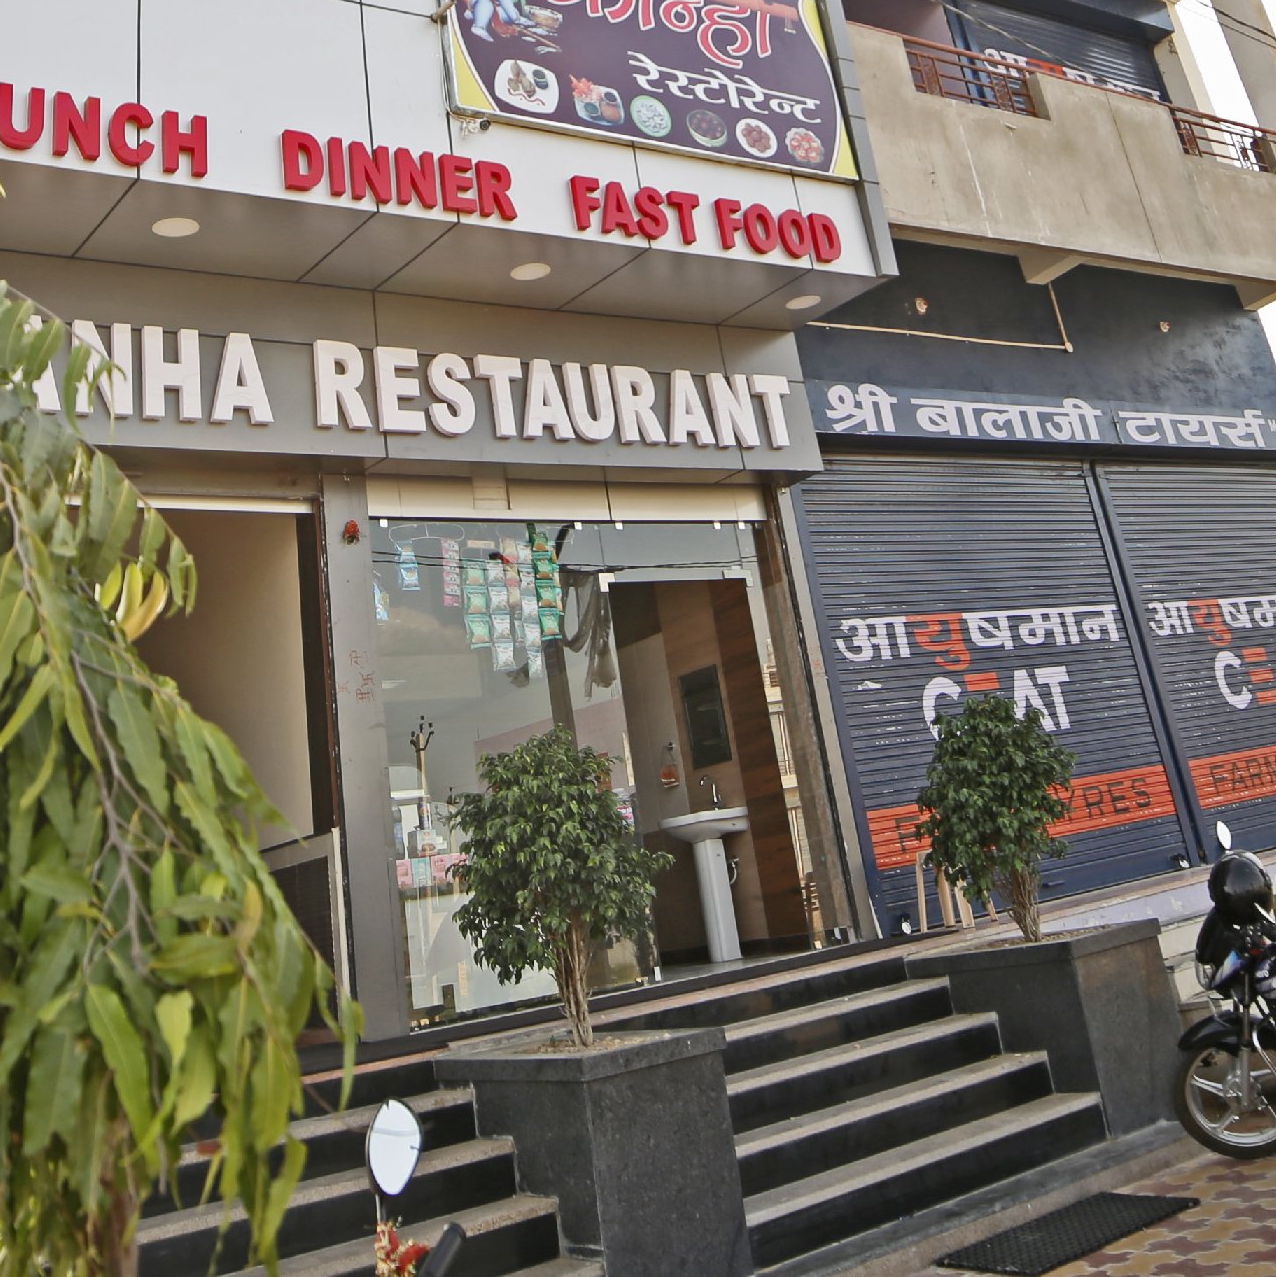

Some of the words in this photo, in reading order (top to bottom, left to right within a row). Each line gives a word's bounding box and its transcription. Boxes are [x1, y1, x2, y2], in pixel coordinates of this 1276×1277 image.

[280, 128, 518, 221] DINNER
[569, 174, 699, 245] FAST
[714, 197, 842, 263] FOOD
[312, 339, 791, 449] RESTAURANT
[825, 384, 897, 434] श्री
[910, 397, 1103, 443] बालाजी
[1118, 408, 1268, 448] टायर्स
[1051, 777, 1152, 822] YRES
